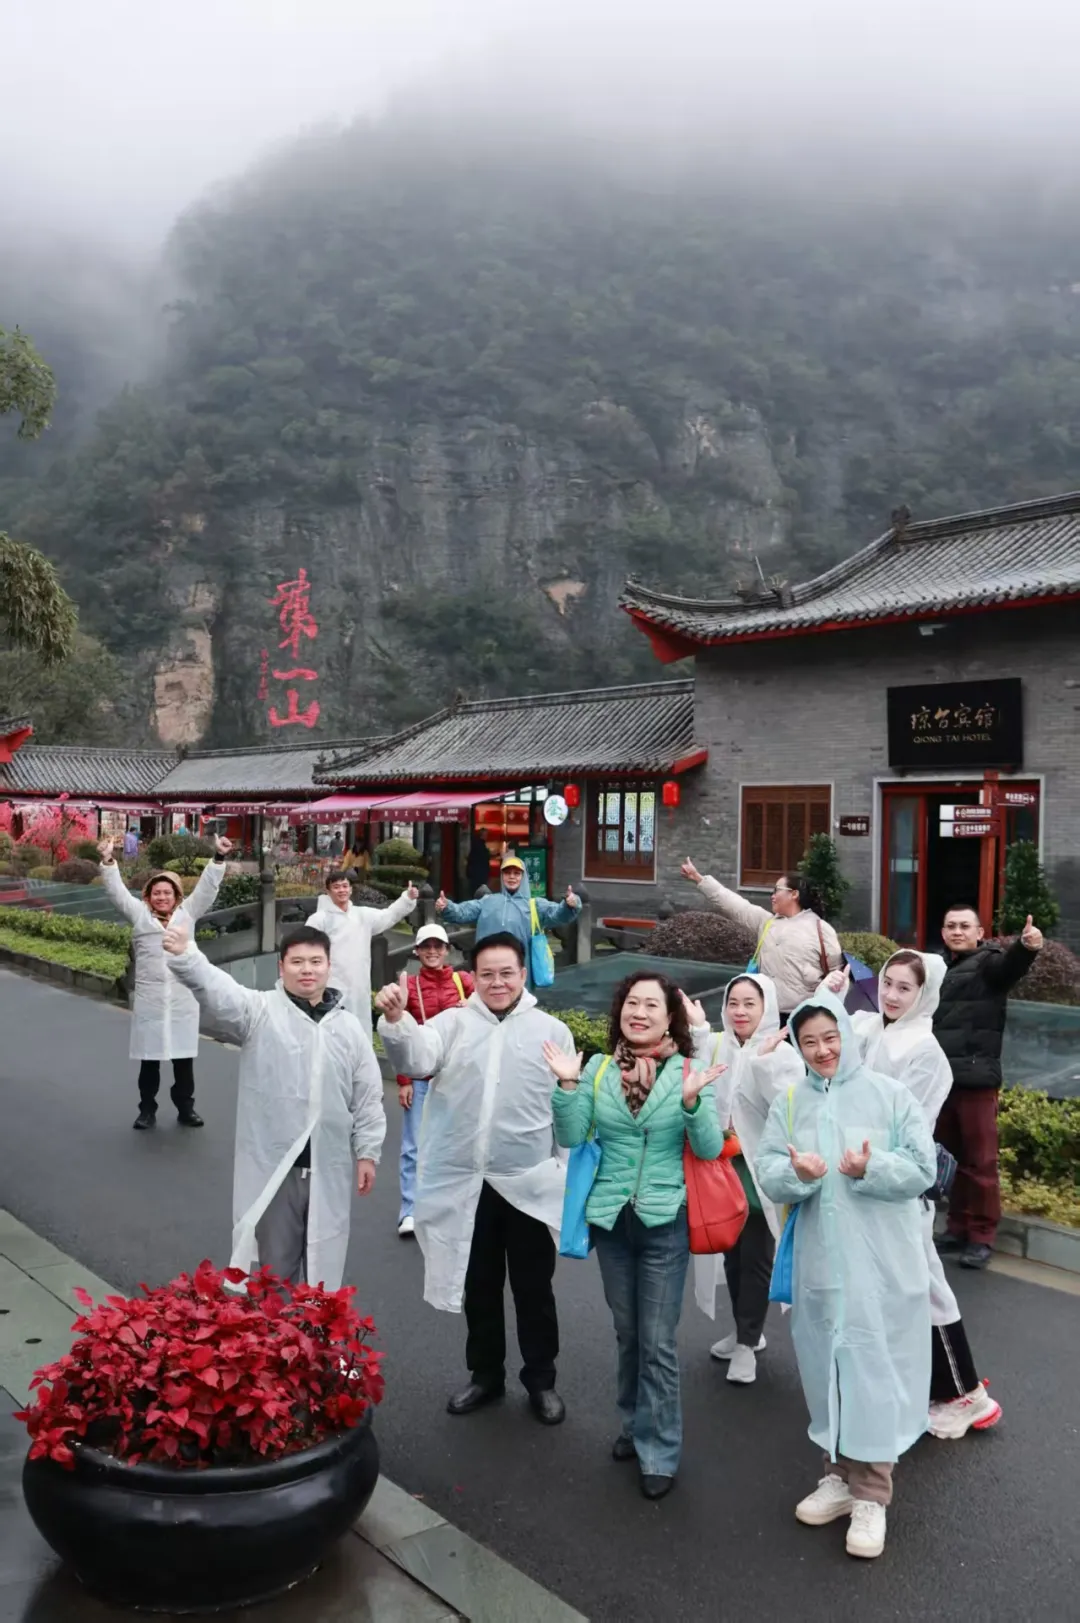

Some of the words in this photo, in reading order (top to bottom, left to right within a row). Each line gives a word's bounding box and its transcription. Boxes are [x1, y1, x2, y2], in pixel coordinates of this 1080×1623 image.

[913, 735, 942, 744] QIONG
[946, 734, 960, 743] TAI
[962, 732, 992, 742] HOTEL
